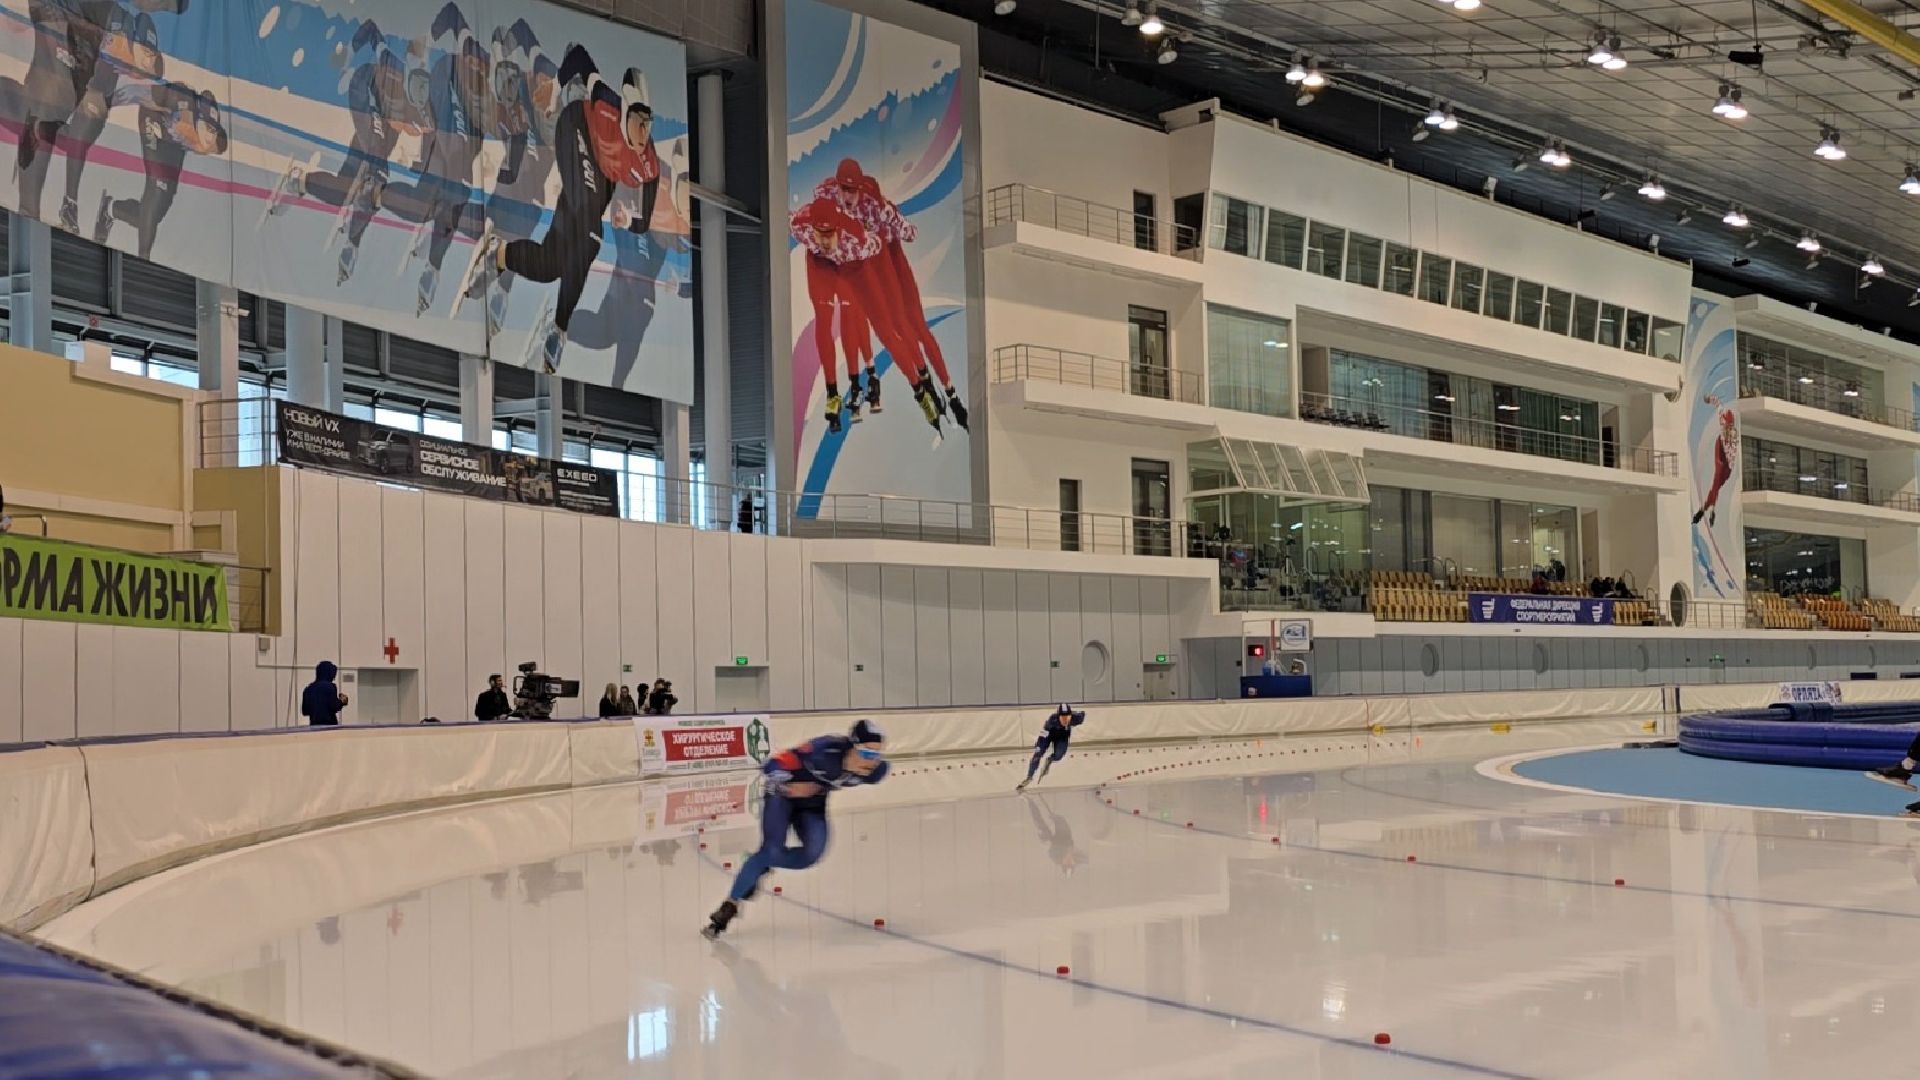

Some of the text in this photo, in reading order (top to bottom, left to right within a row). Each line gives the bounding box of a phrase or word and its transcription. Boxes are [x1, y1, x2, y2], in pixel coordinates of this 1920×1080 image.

[284, 408, 340, 433] НОВЫЙ VX
[420, 451, 480, 471] СЕРВИСНОЕ
[420, 463, 507, 487] ОБСЛУЖИВАНИЕ
[556, 468, 597, 482] EXEED
[0, 547, 218, 624] РМА ЖИЗНИ
[1510, 599, 1550, 610] ФЕДЕРАЛЬНАЯ
[672, 731, 736, 744] ХИРУРГИЧЕСКОЕ
[683, 744, 728, 758] ОТДЕЛЕНИЕ
